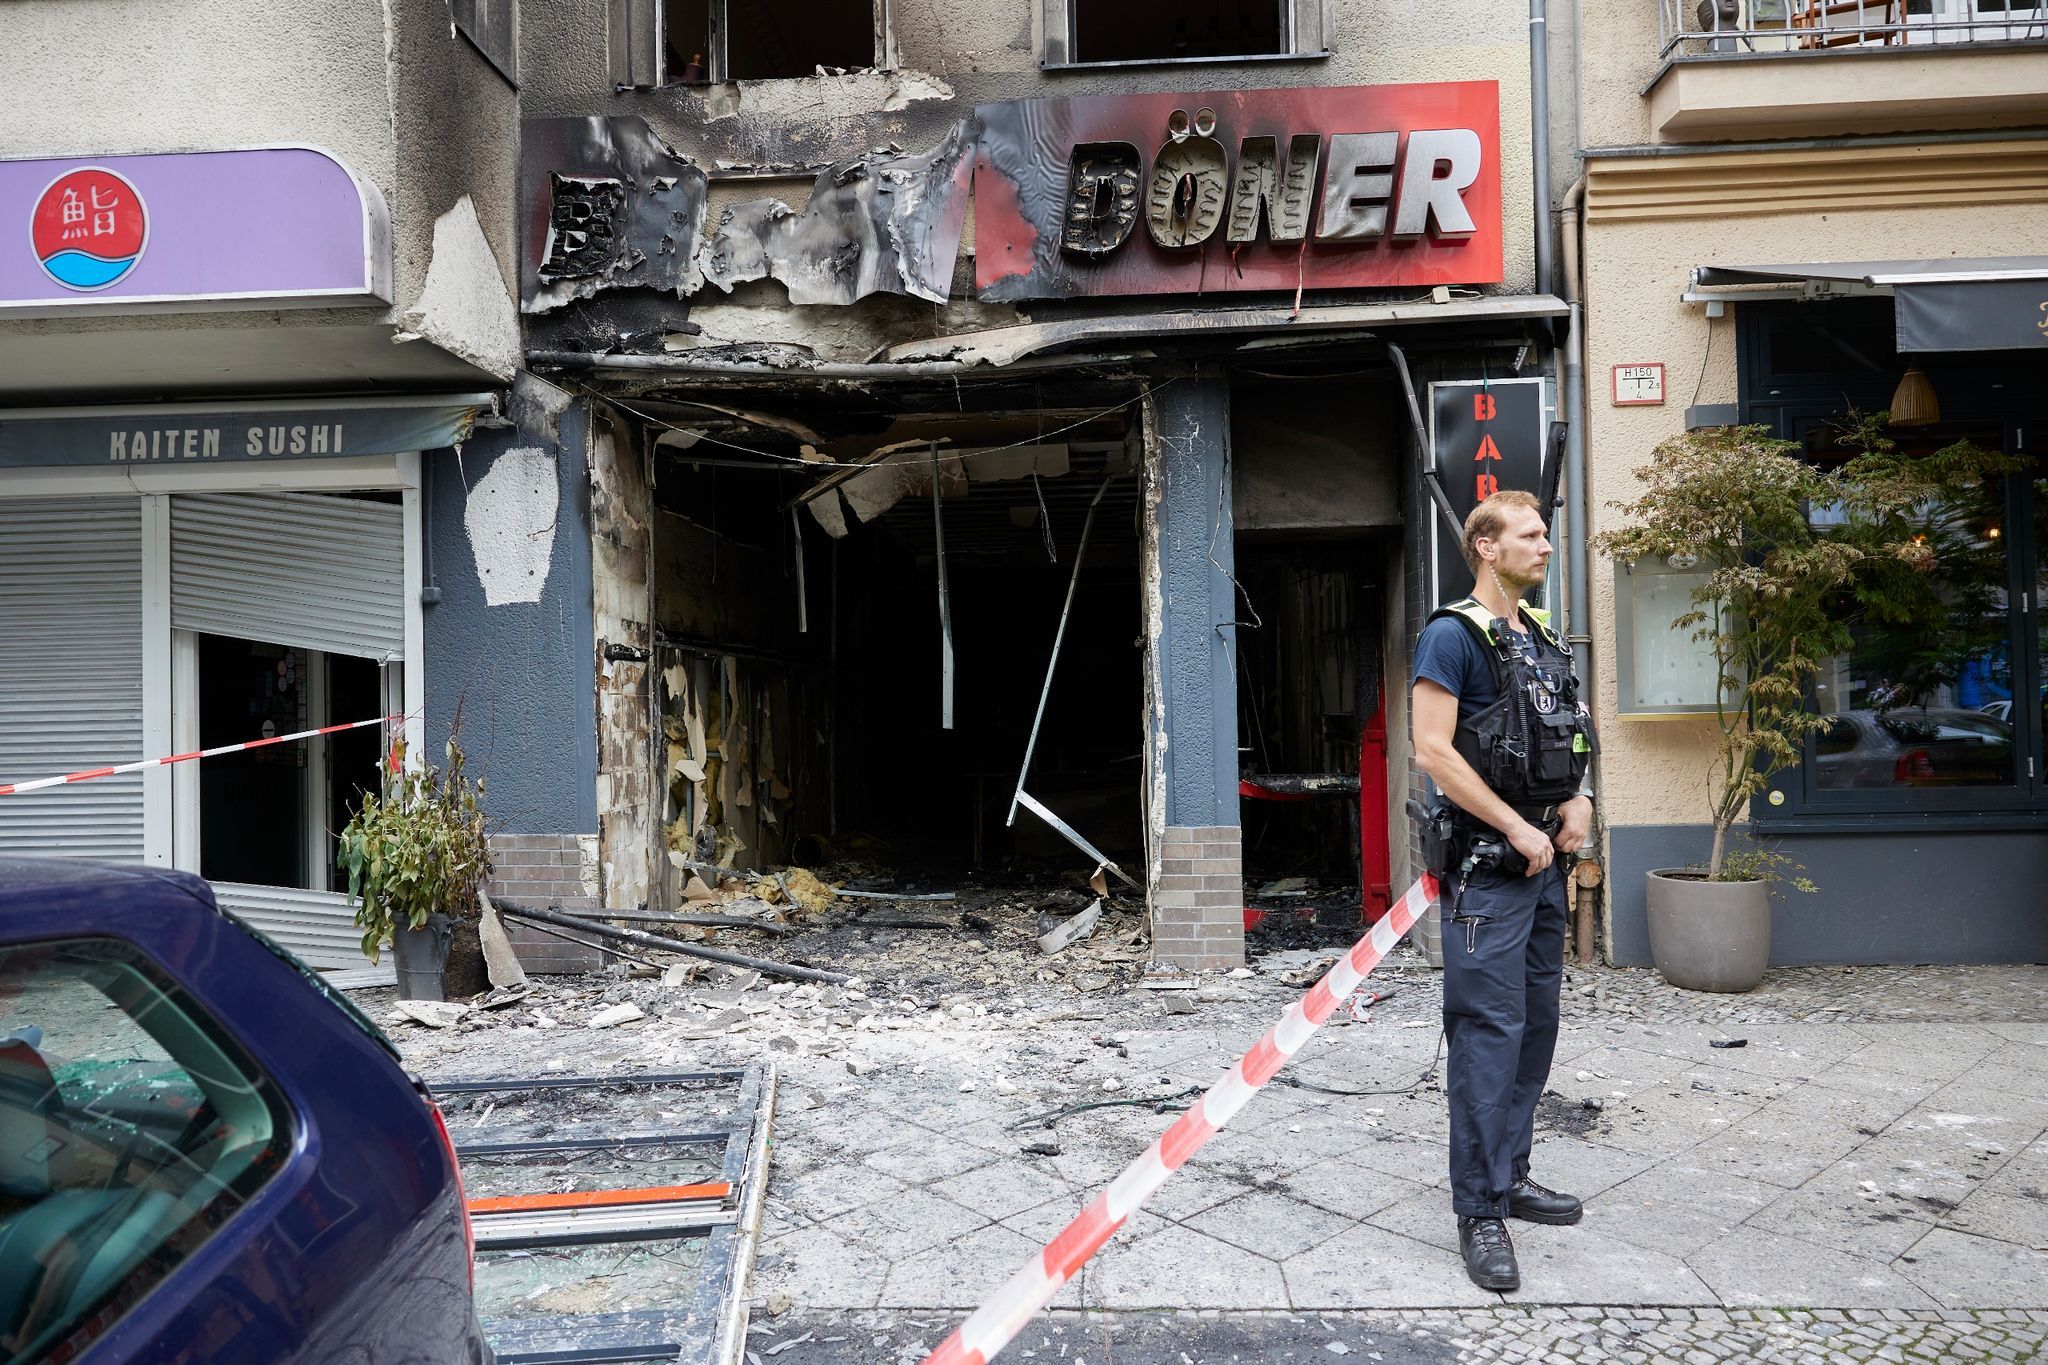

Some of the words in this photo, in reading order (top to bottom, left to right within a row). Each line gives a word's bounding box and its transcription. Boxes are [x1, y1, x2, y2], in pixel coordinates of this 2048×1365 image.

[1059, 106, 1482, 254] DÖNER
[109, 428, 220, 461] KAITEN
[246, 424, 344, 455] SUSHI
